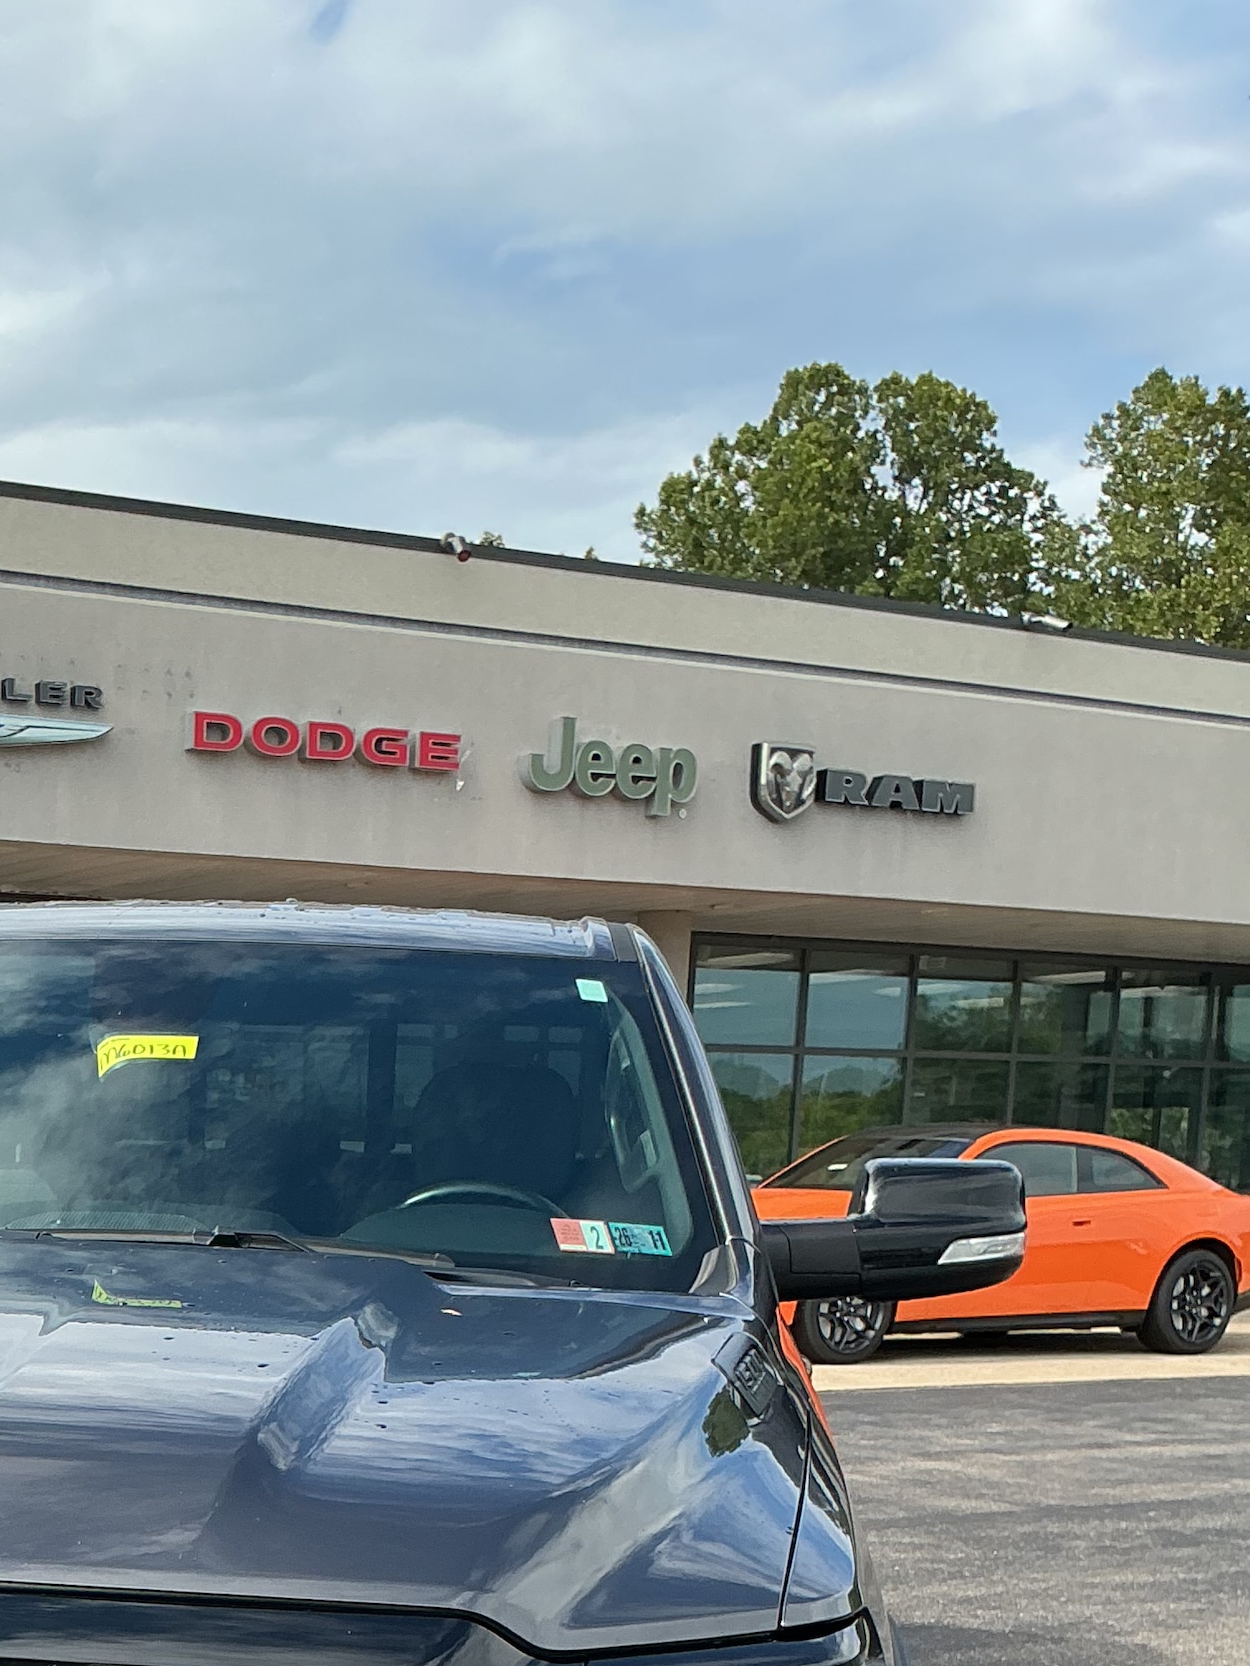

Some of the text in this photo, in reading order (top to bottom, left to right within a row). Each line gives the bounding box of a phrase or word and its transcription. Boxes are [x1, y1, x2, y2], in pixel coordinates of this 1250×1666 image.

[187, 710, 462, 771] DODGE
[522, 716, 697, 818] Jeep
[816, 768, 976, 815] RAM
[590, 1226, 604, 1250] 2
